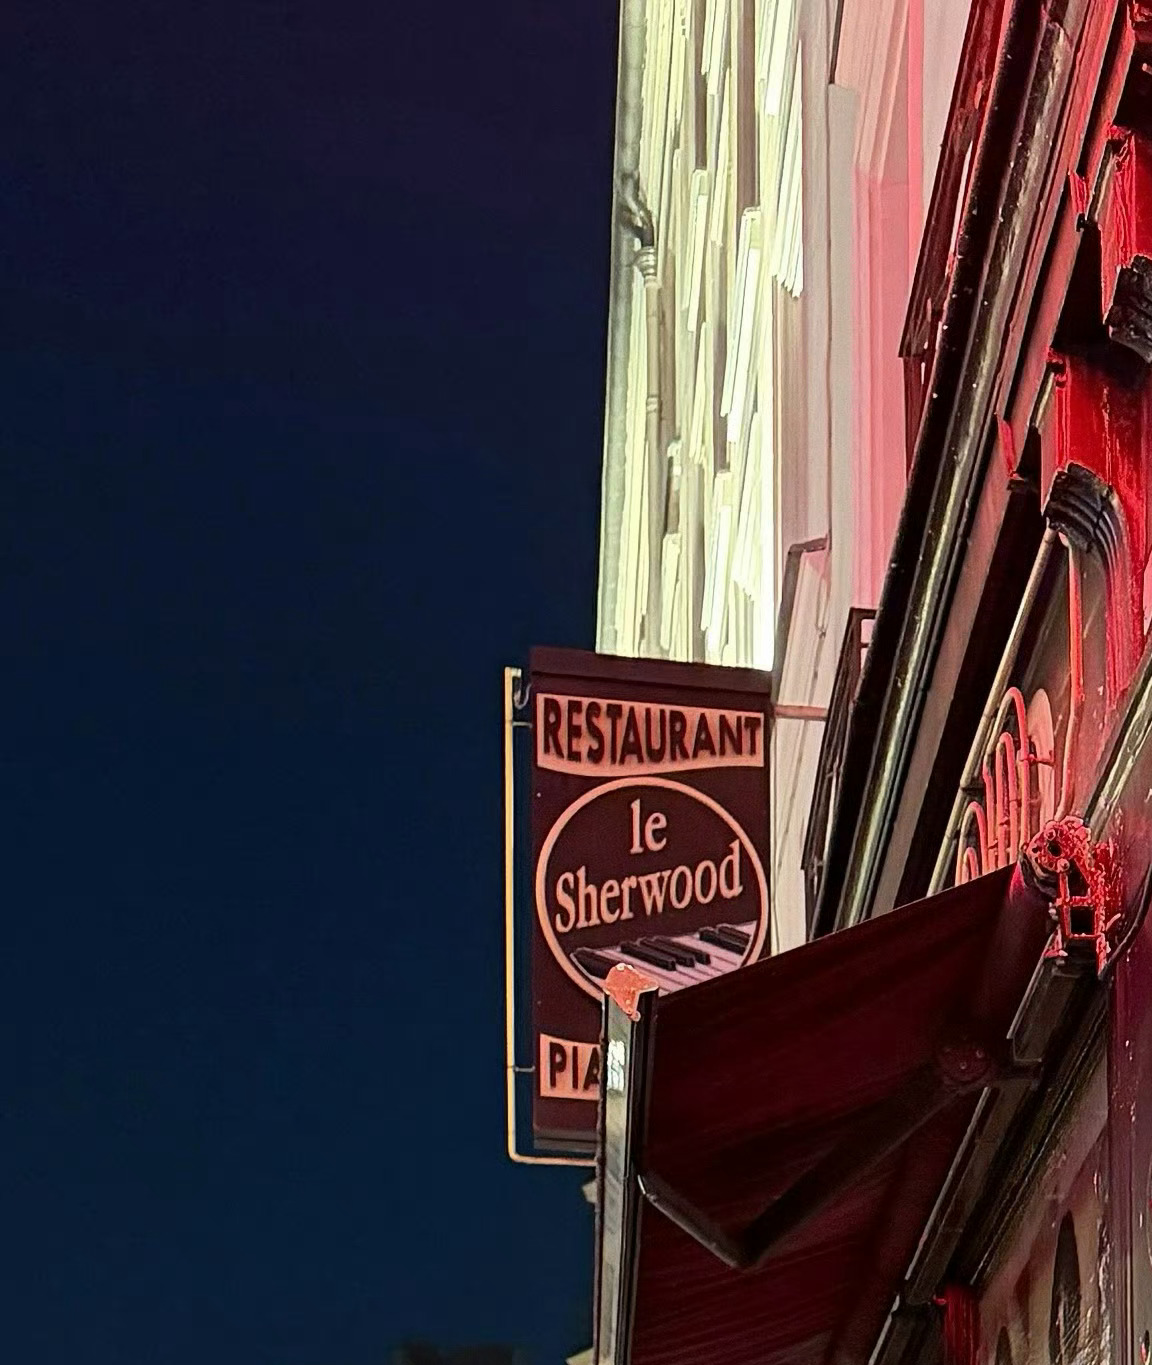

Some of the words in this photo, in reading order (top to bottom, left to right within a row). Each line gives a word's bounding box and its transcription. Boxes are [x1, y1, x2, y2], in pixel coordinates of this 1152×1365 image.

[543, 698, 762, 766] RESTAURANT
[629, 799, 668, 856] le
[555, 840, 744, 935] Sherwood
